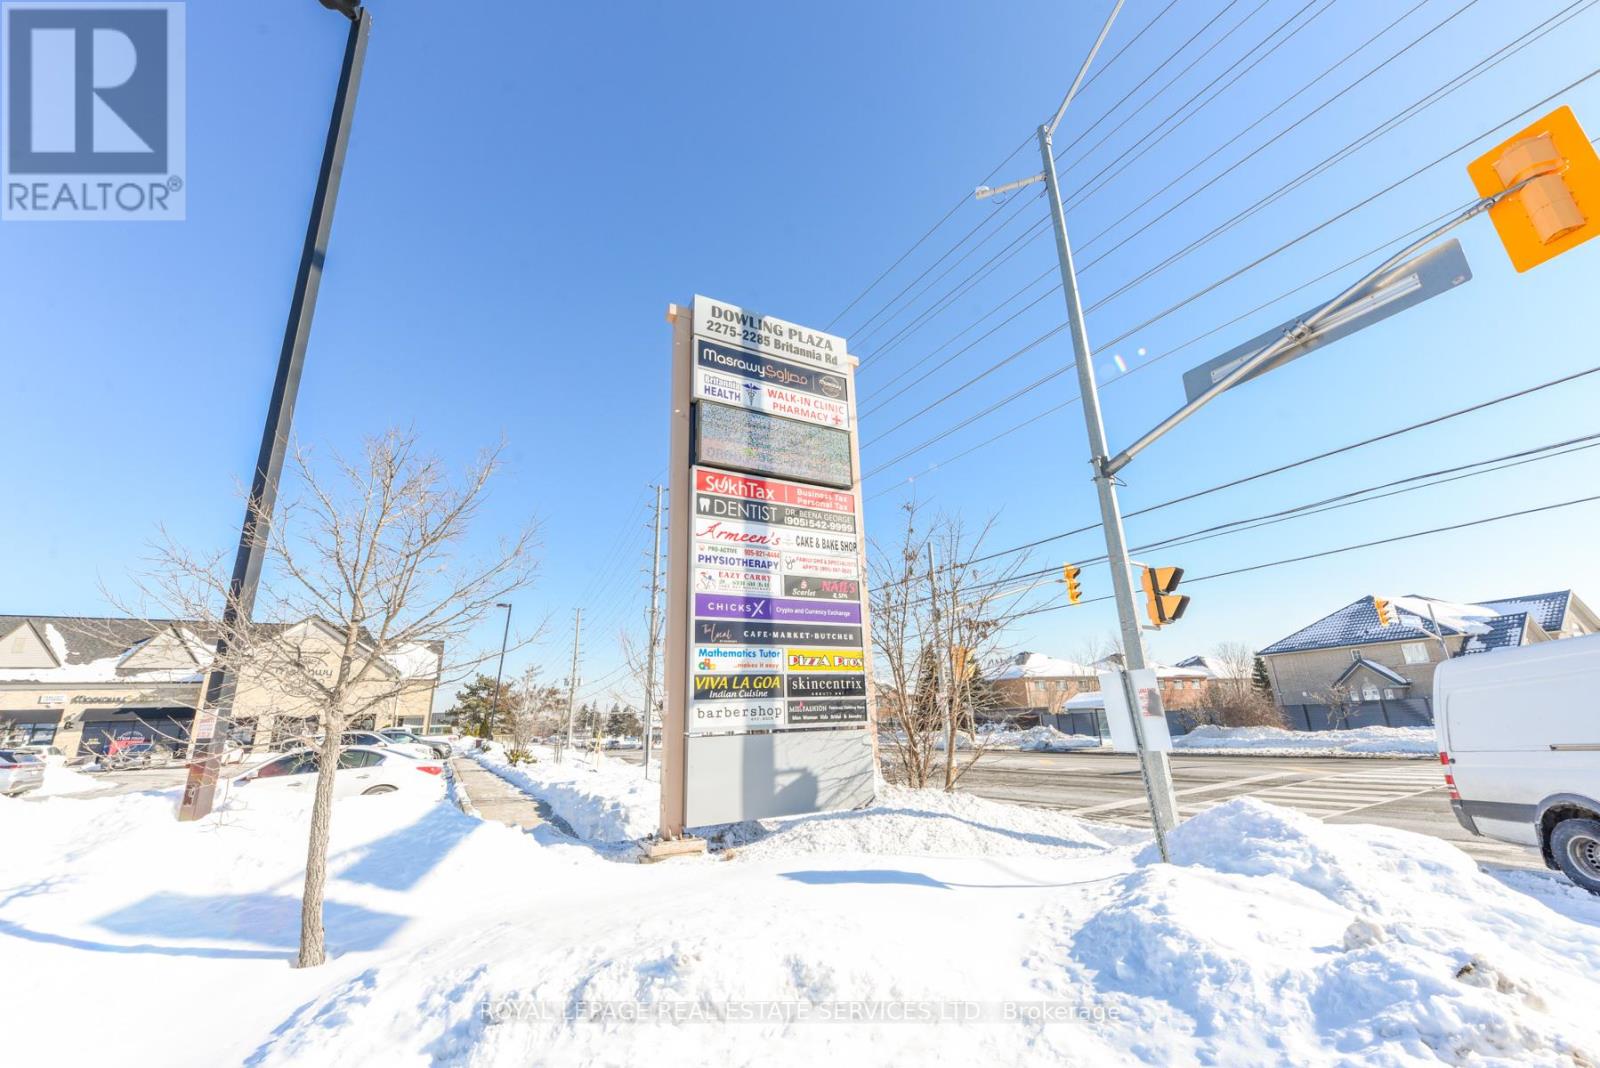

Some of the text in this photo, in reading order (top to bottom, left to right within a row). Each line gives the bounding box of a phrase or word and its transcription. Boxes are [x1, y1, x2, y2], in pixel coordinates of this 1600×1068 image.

[711, 305, 834, 352] DOWLING PLAZA
[706, 319, 838, 366] 2275-2285 Britannia Rd
[703, 347, 765, 378] Masrawy
[704, 385, 741, 401] HEALTH
[767, 388, 845, 414] WALK-IN CLINIC
[772, 401, 829, 422] PHARMACY
[796, 487, 848, 503] Business Tax
[714, 499, 777, 522] DENTIST
[834, 502, 848, 512] Tax
[800, 510, 822, 520] BEENA
[823, 513, 850, 525] GEORGE
[696, 521, 781, 546] Armeen's
[796, 535, 857, 552] CAKE & BAKE SHOP
[698, 554, 779, 569] PHYSIOTHERAPY
[698, 649, 780, 658] Mathematics Tutor
[788, 655, 831, 666] PIZZA
[695, 675, 781, 689] VIVA LA GOA
[792, 676, 863, 690] skincentrix
[709, 690, 769, 698] Indian Cuisine
[697, 706, 782, 719] barbershop
